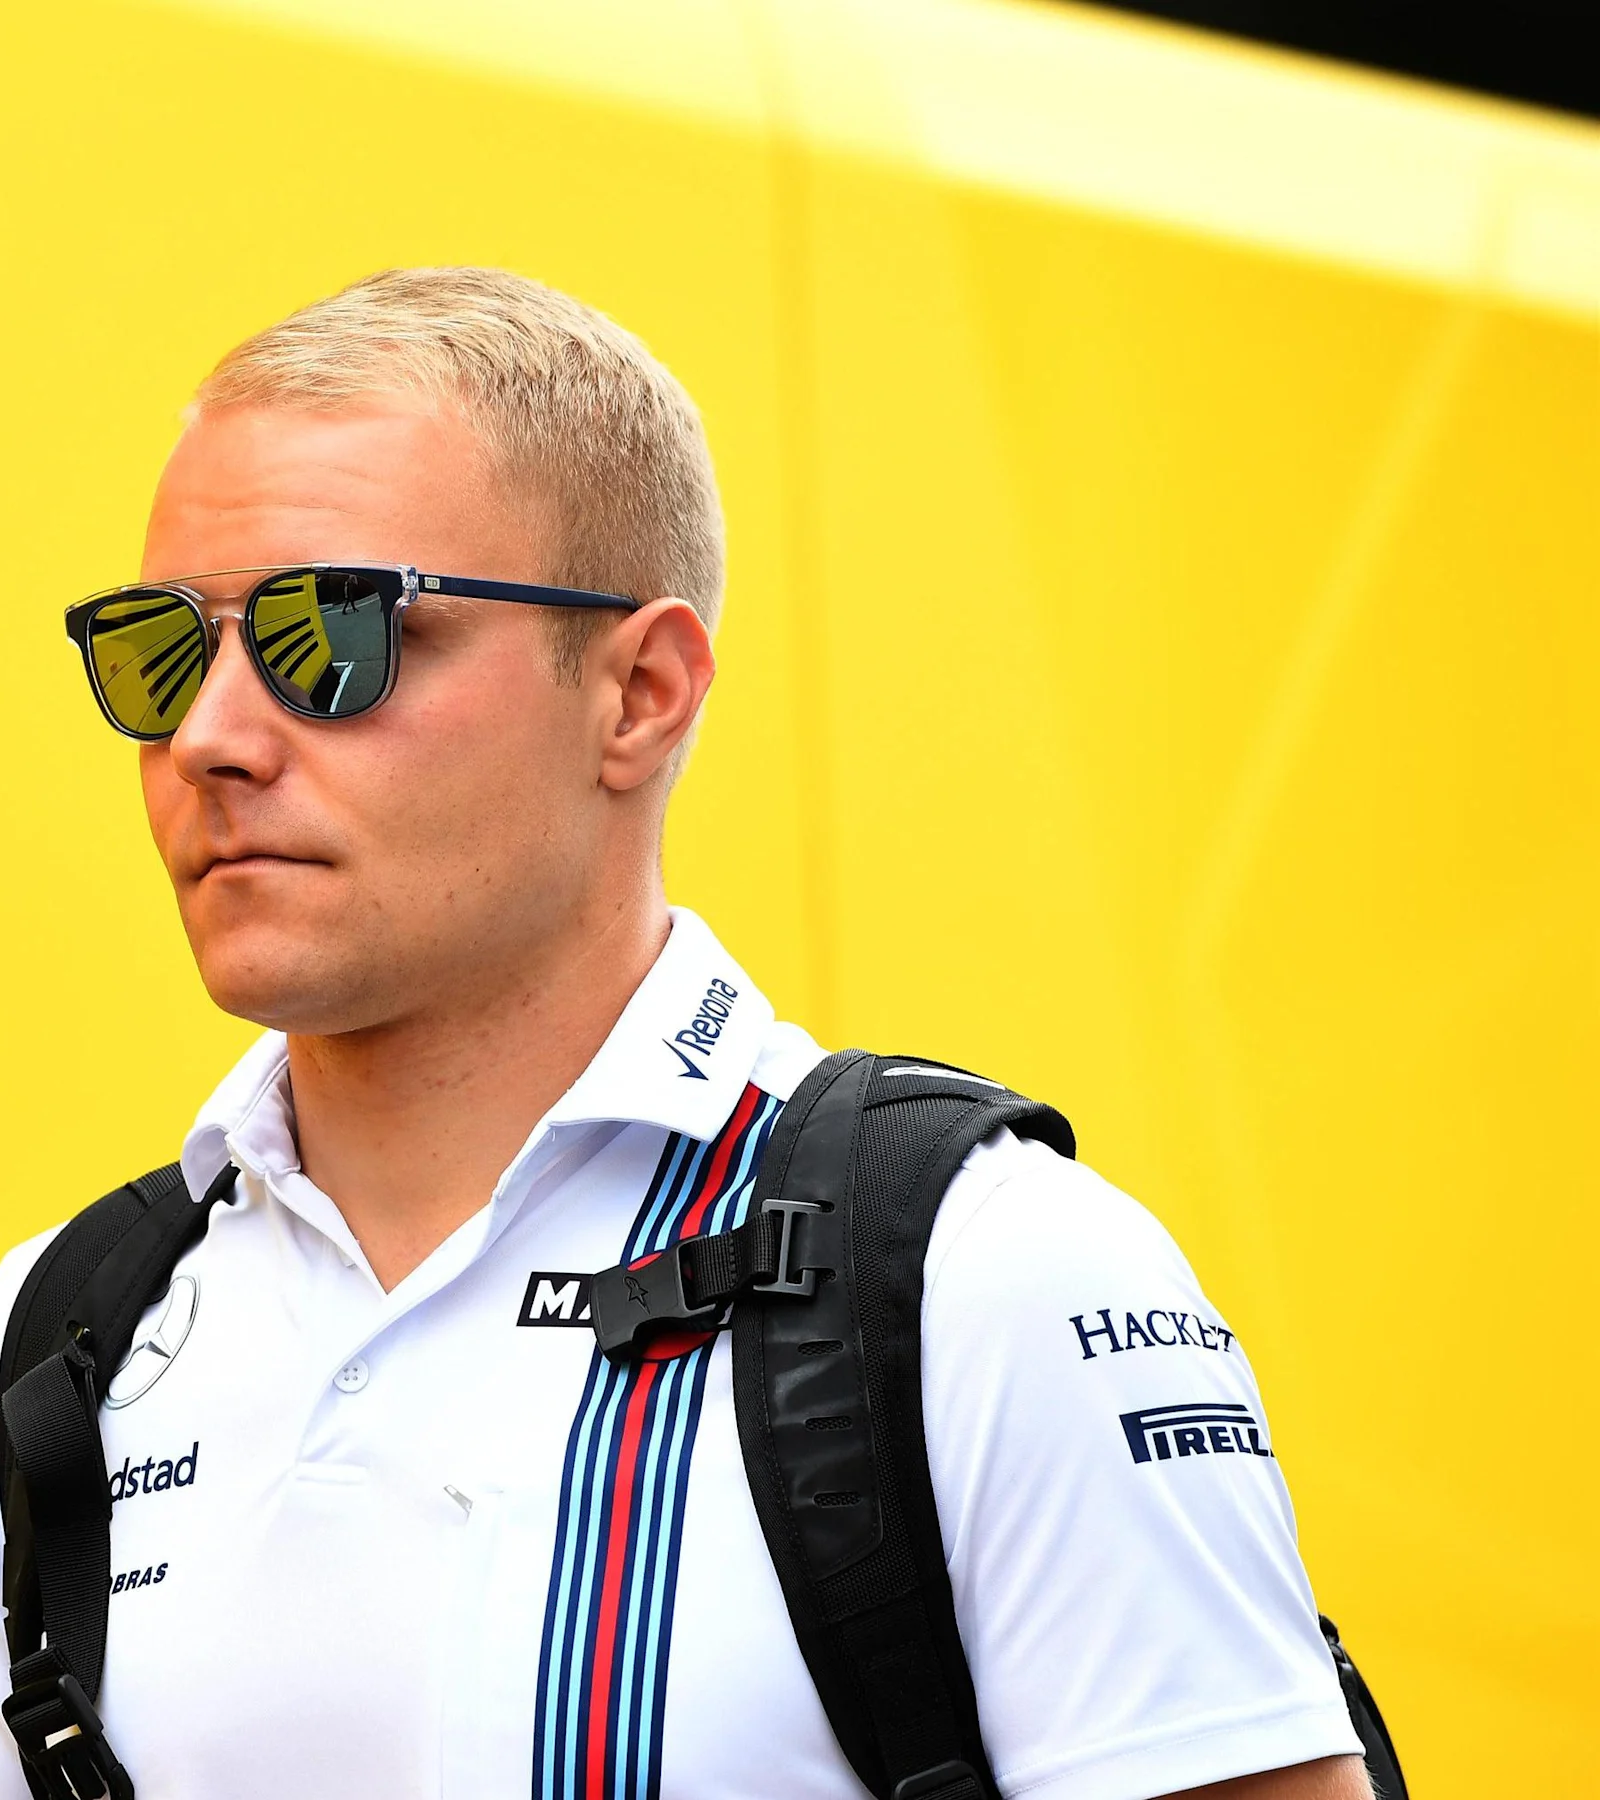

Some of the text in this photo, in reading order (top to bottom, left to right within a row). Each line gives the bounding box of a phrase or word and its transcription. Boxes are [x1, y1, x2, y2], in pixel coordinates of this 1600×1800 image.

[674, 978, 739, 1056] Rexona
[1119, 1403, 1275, 1464] PIRELL
[109, 1441, 199, 1503] dstad
[110, 1562, 169, 1595] BRAS
